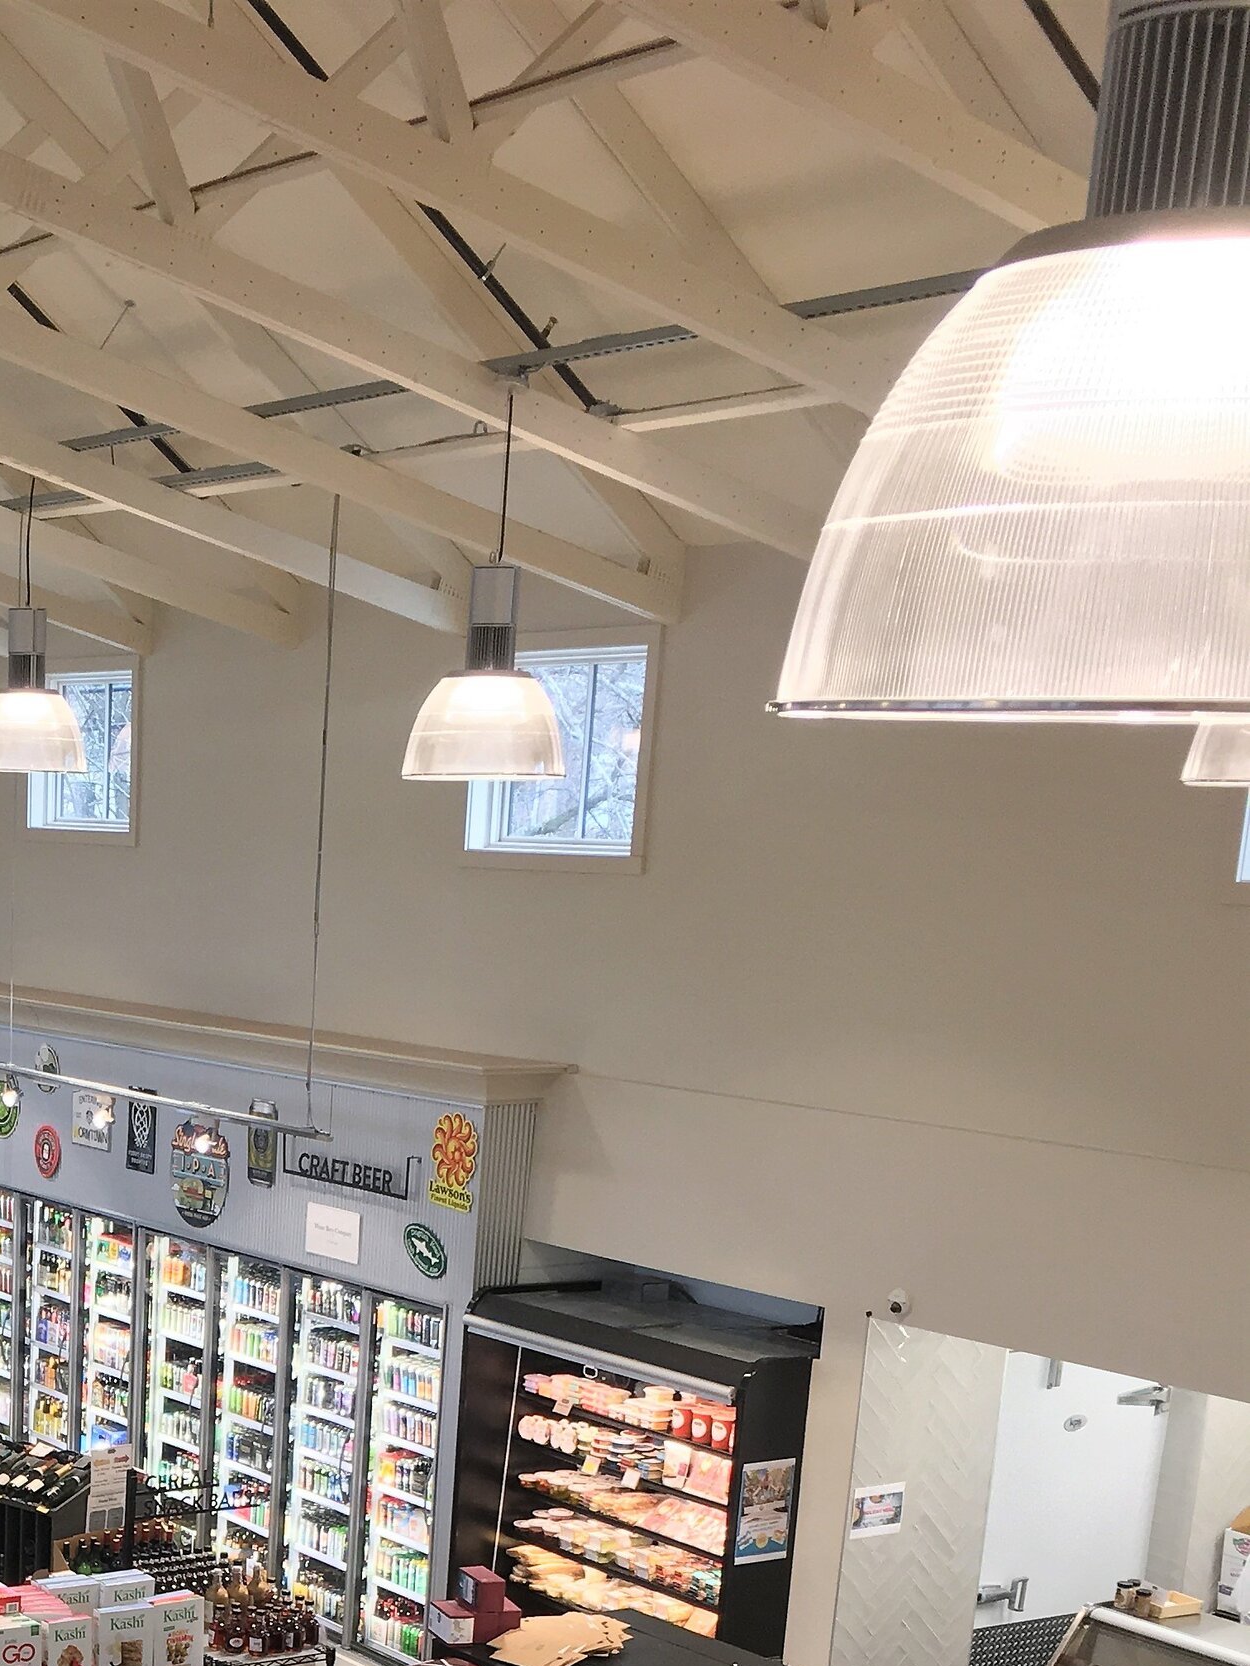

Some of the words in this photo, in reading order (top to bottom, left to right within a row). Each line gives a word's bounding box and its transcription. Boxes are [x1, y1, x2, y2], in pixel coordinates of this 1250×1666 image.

[298, 1152, 349, 1184] CRAFT
[352, 1162, 394, 1194] BEER
[429, 1178, 472, 1206] Lawson's
[114, 1586, 147, 1602] Kashi
[110, 1614, 145, 1632] Kashi
[163, 1606, 196, 1624] Kashi
[54, 1627, 87, 1643] Kashi
